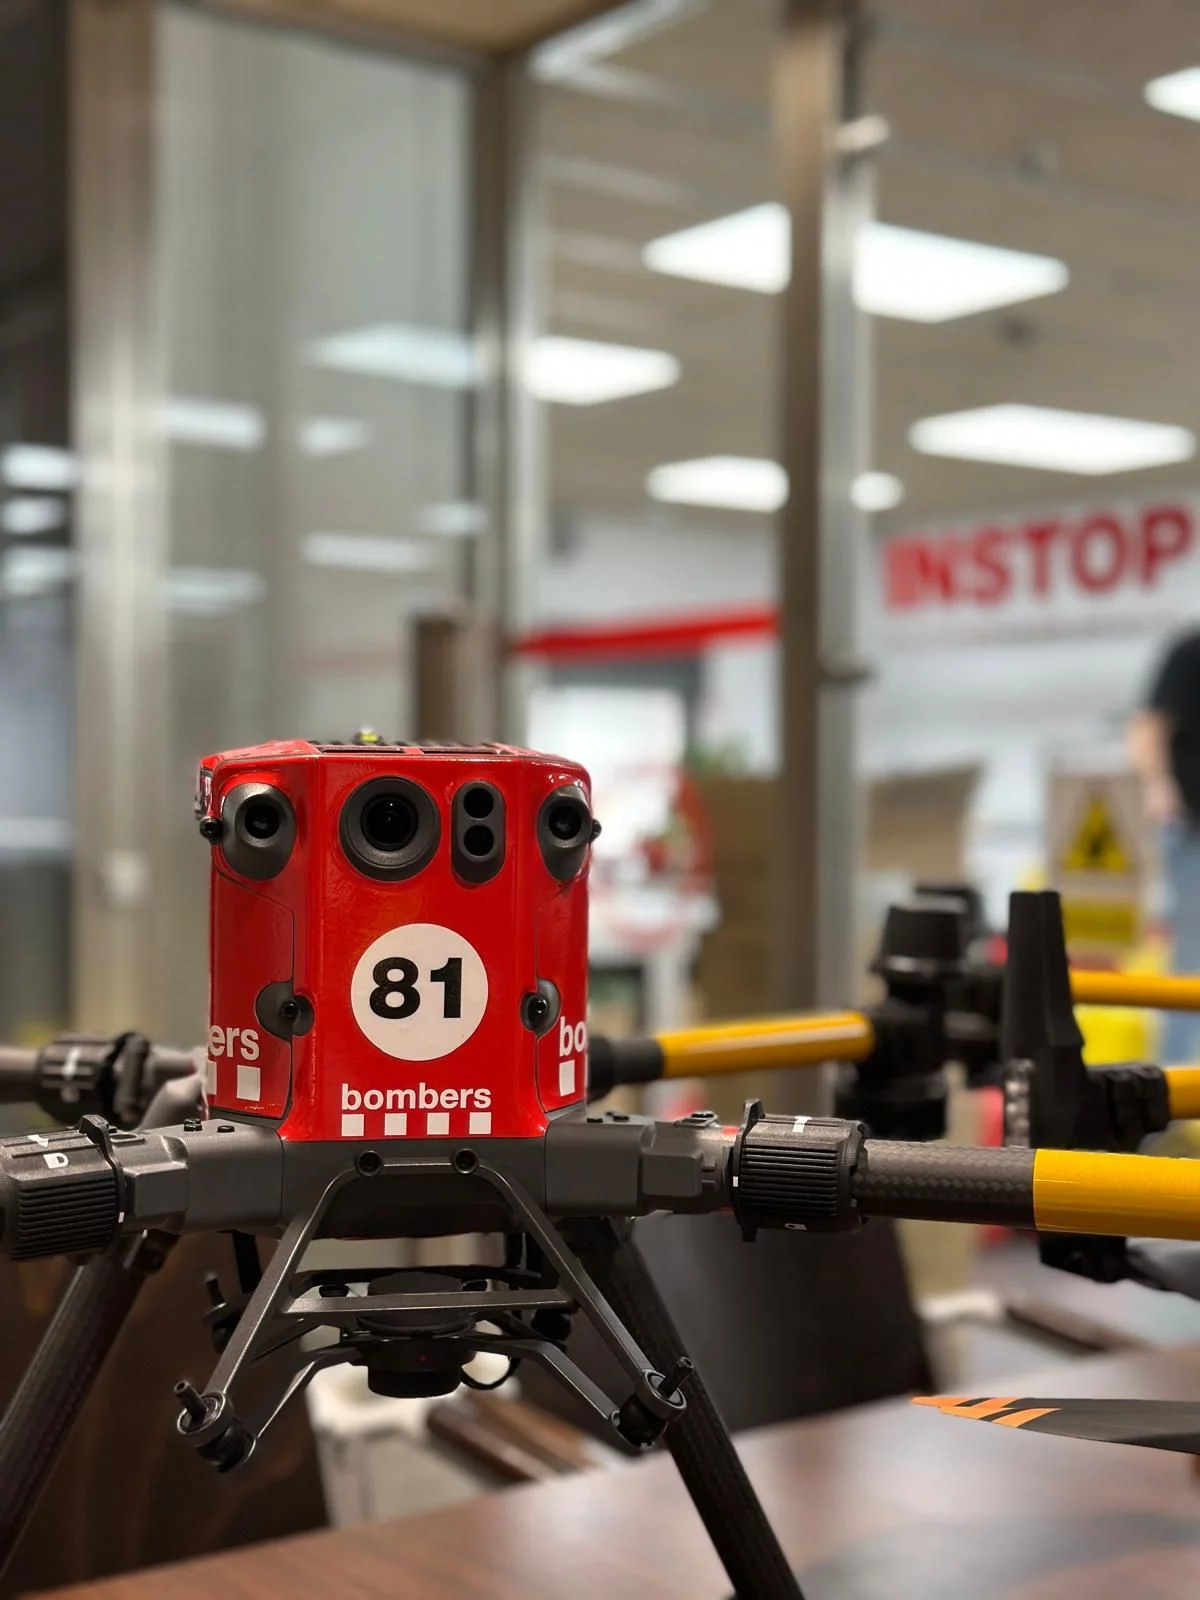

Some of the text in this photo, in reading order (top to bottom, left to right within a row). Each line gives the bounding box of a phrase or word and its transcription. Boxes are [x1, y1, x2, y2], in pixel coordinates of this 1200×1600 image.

[884, 504, 1193, 612] INSTOP
[368, 956, 463, 1019] 81
[341, 1082, 491, 1110] bombers
